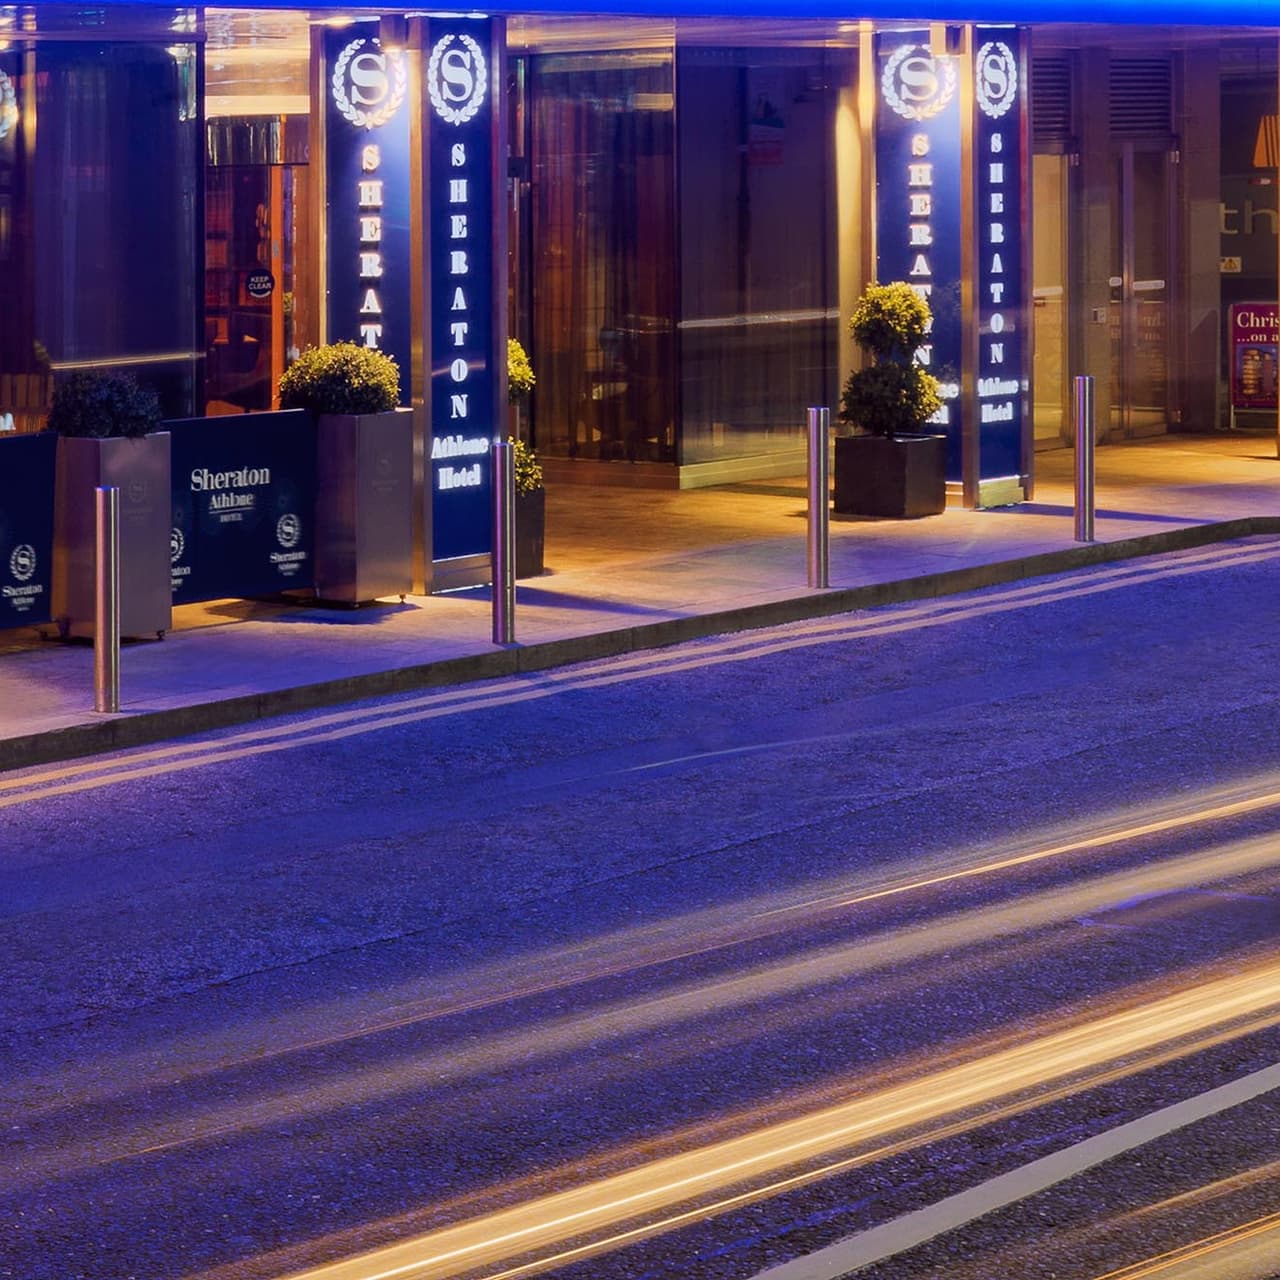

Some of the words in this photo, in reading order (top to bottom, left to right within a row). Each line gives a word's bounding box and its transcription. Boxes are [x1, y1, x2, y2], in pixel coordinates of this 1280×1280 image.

[357, 143, 384, 349] SHERAT
[989, 132, 1005, 364] SHERATON
[448, 142, 469, 419] SHERATON
[1237, 311, 1279, 328] Chris
[431, 434, 489, 459] Athlone
[191, 465, 271, 492] Sheraton
[438, 463, 481, 490] Hotel
[209, 492, 255, 510] Athlone
